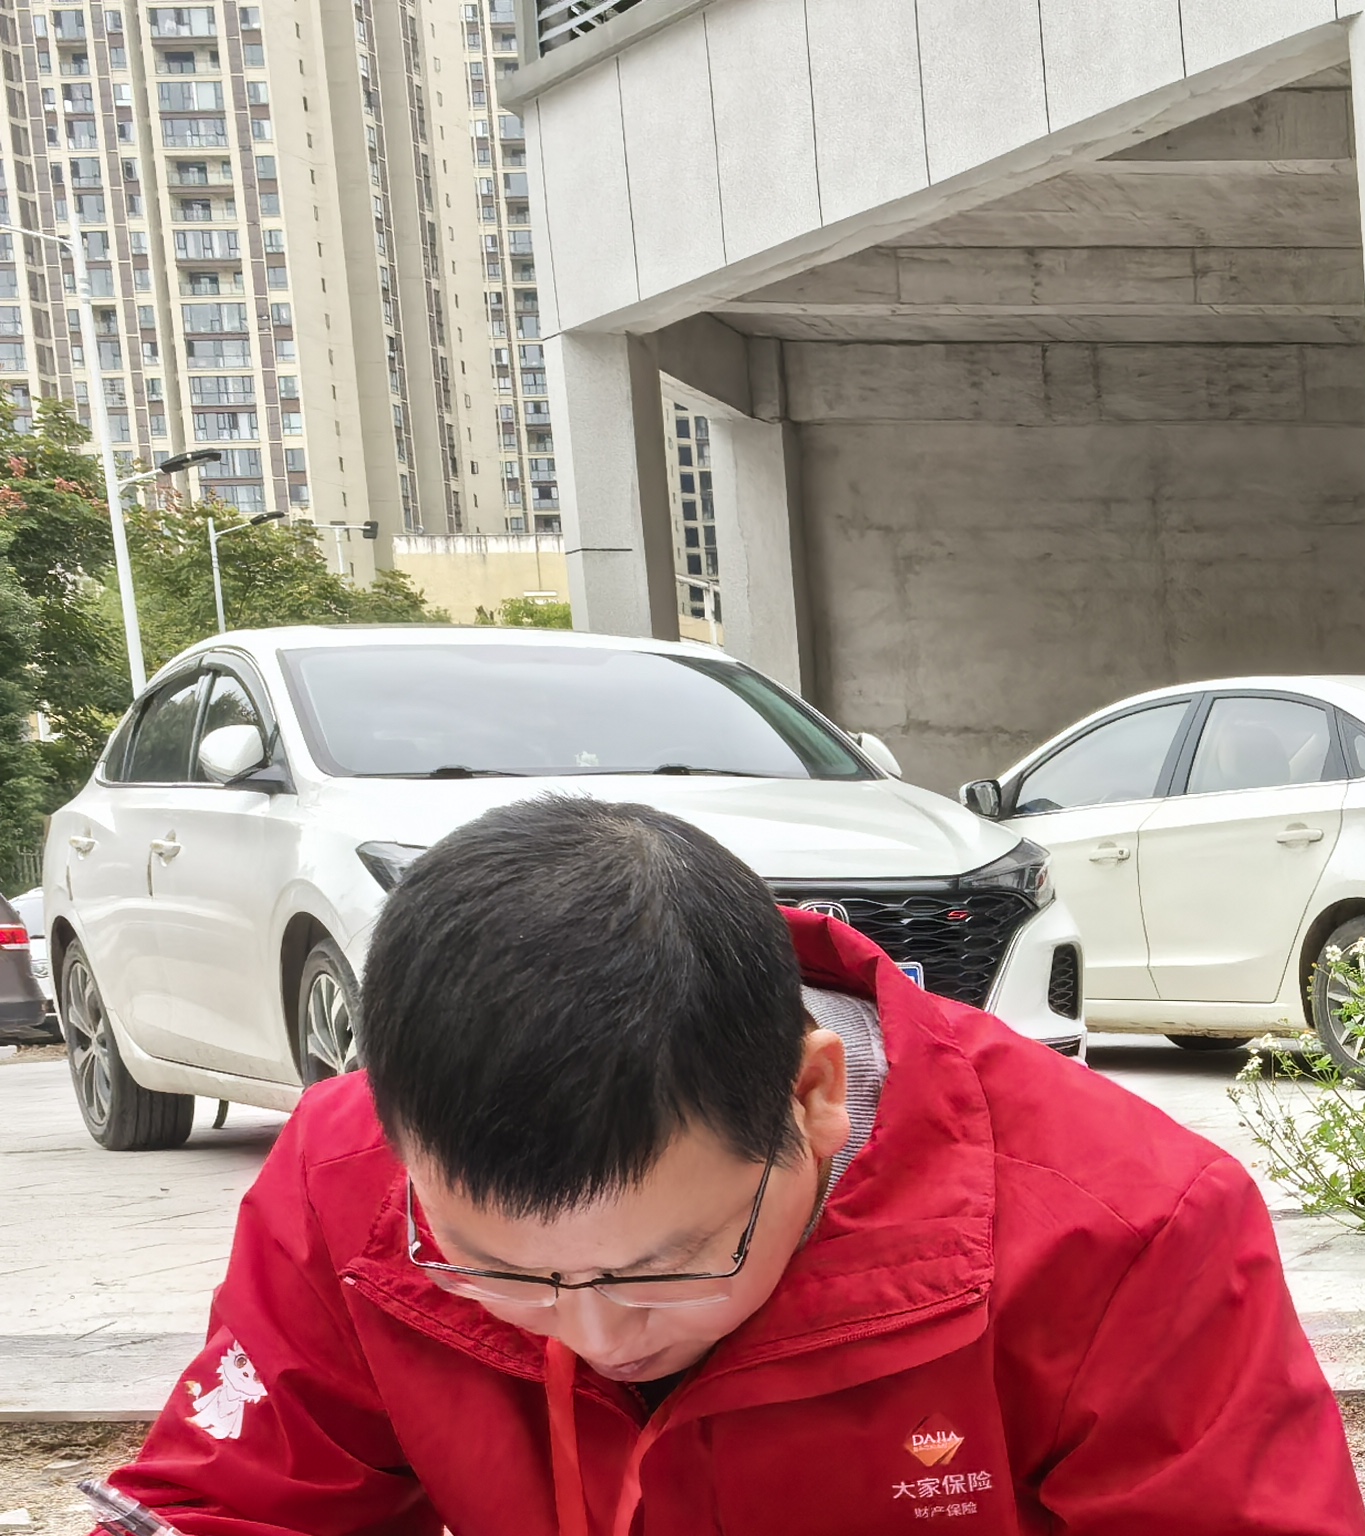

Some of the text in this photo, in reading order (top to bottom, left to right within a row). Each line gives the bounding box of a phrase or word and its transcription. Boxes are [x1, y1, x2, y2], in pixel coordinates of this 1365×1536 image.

[892, 1470, 993, 1499] 大家保险
[914, 1501, 978, 1519] 财产保险
